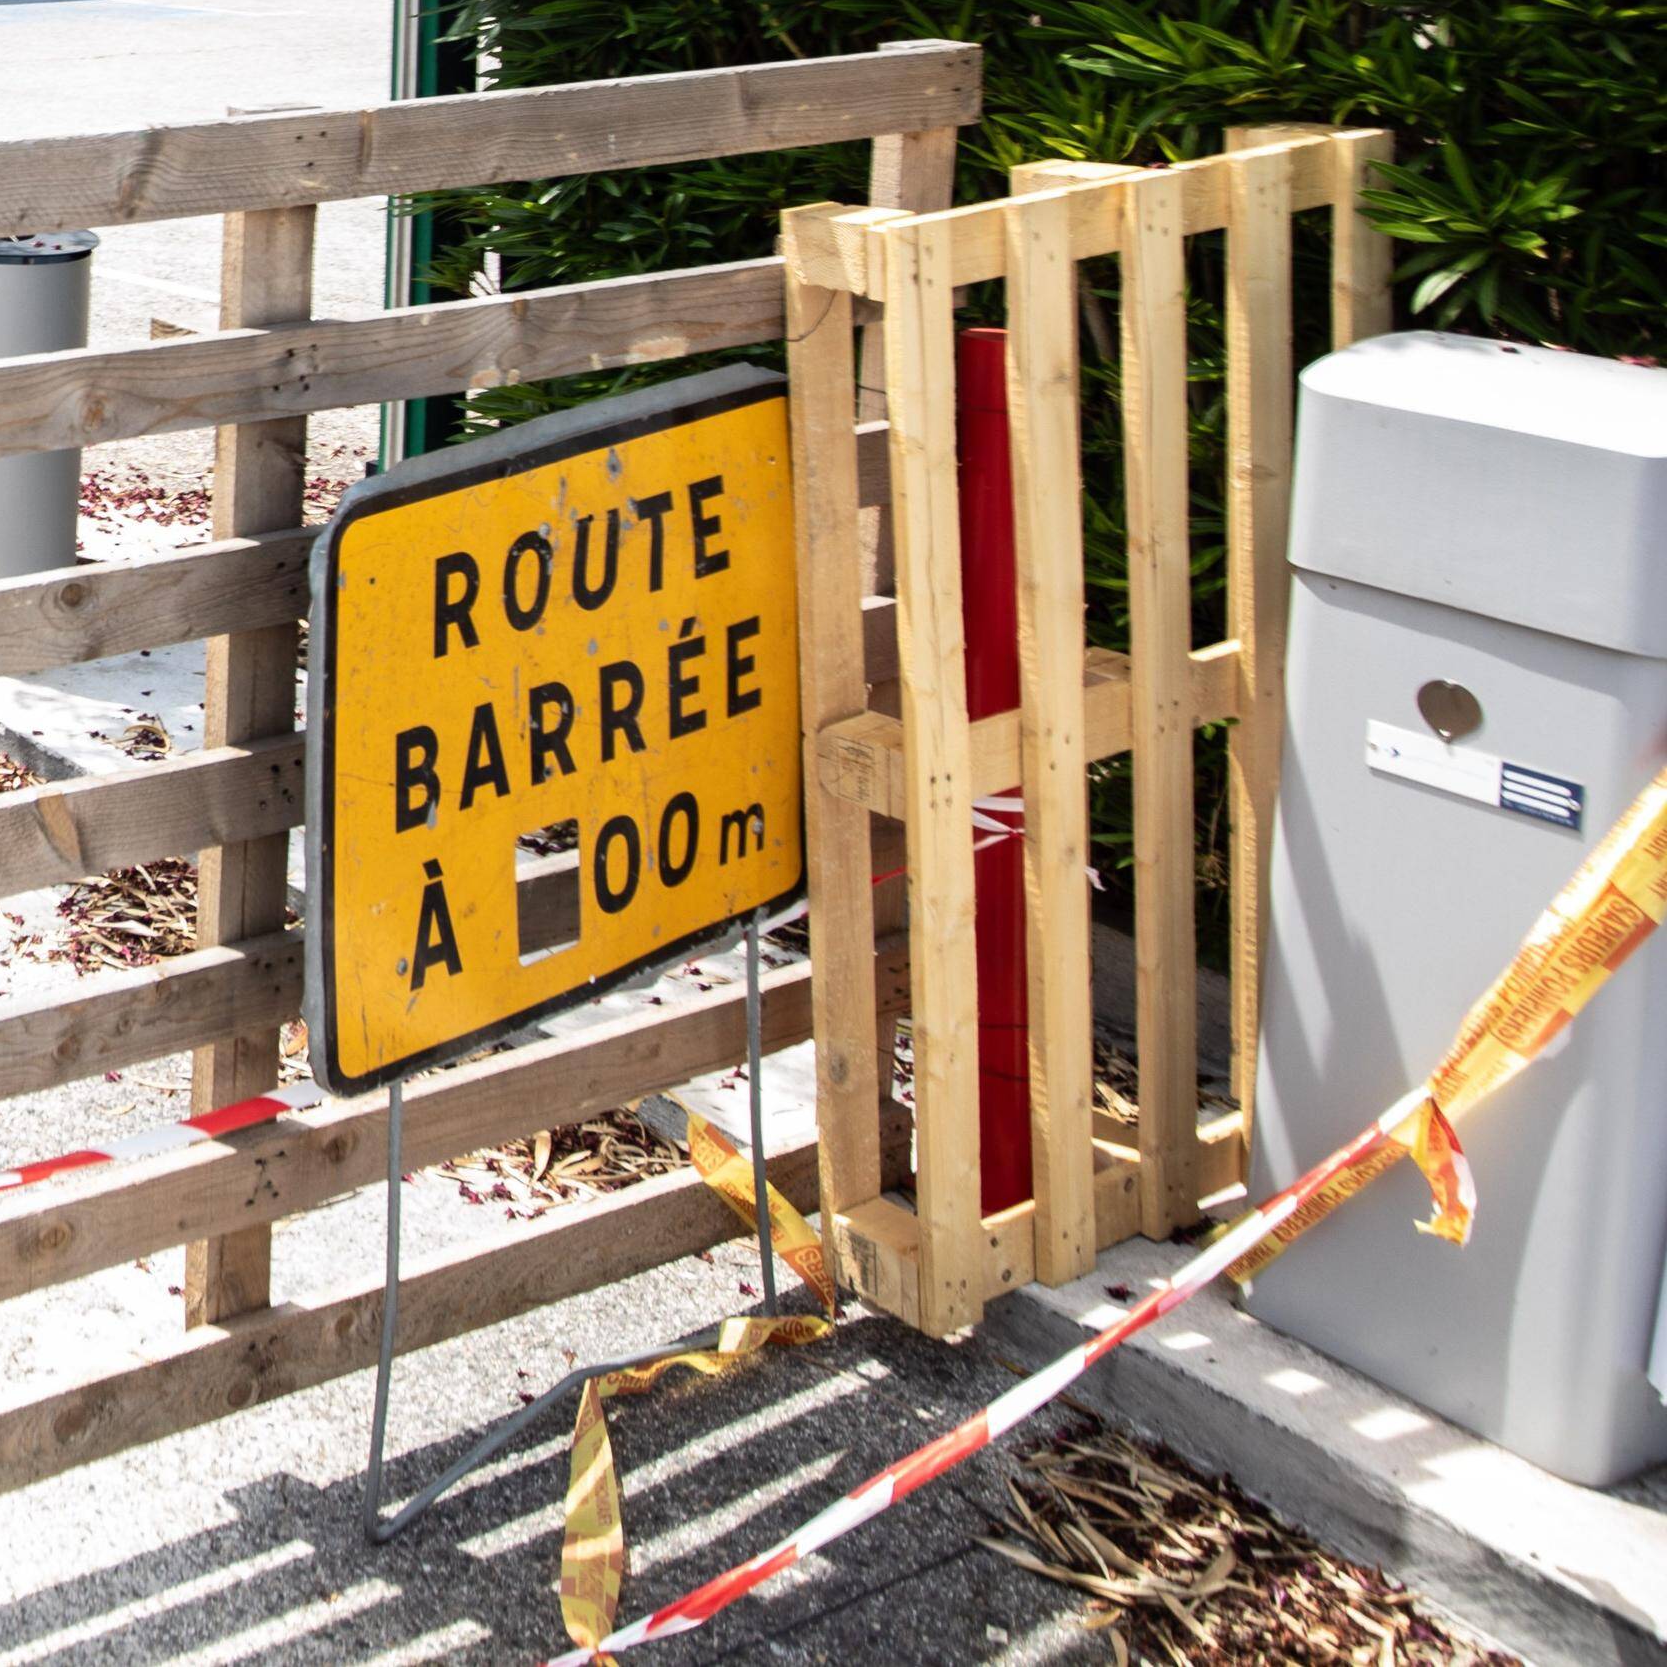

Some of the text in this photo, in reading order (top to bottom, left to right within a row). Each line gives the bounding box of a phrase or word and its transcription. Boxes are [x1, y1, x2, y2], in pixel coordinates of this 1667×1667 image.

[434, 475, 730, 659] ROUTE
[396, 616, 762, 833] BARRÉE
[409, 858, 463, 992] À
[1498, 899, 1641, 1040] SAPEURS POMPIERS
